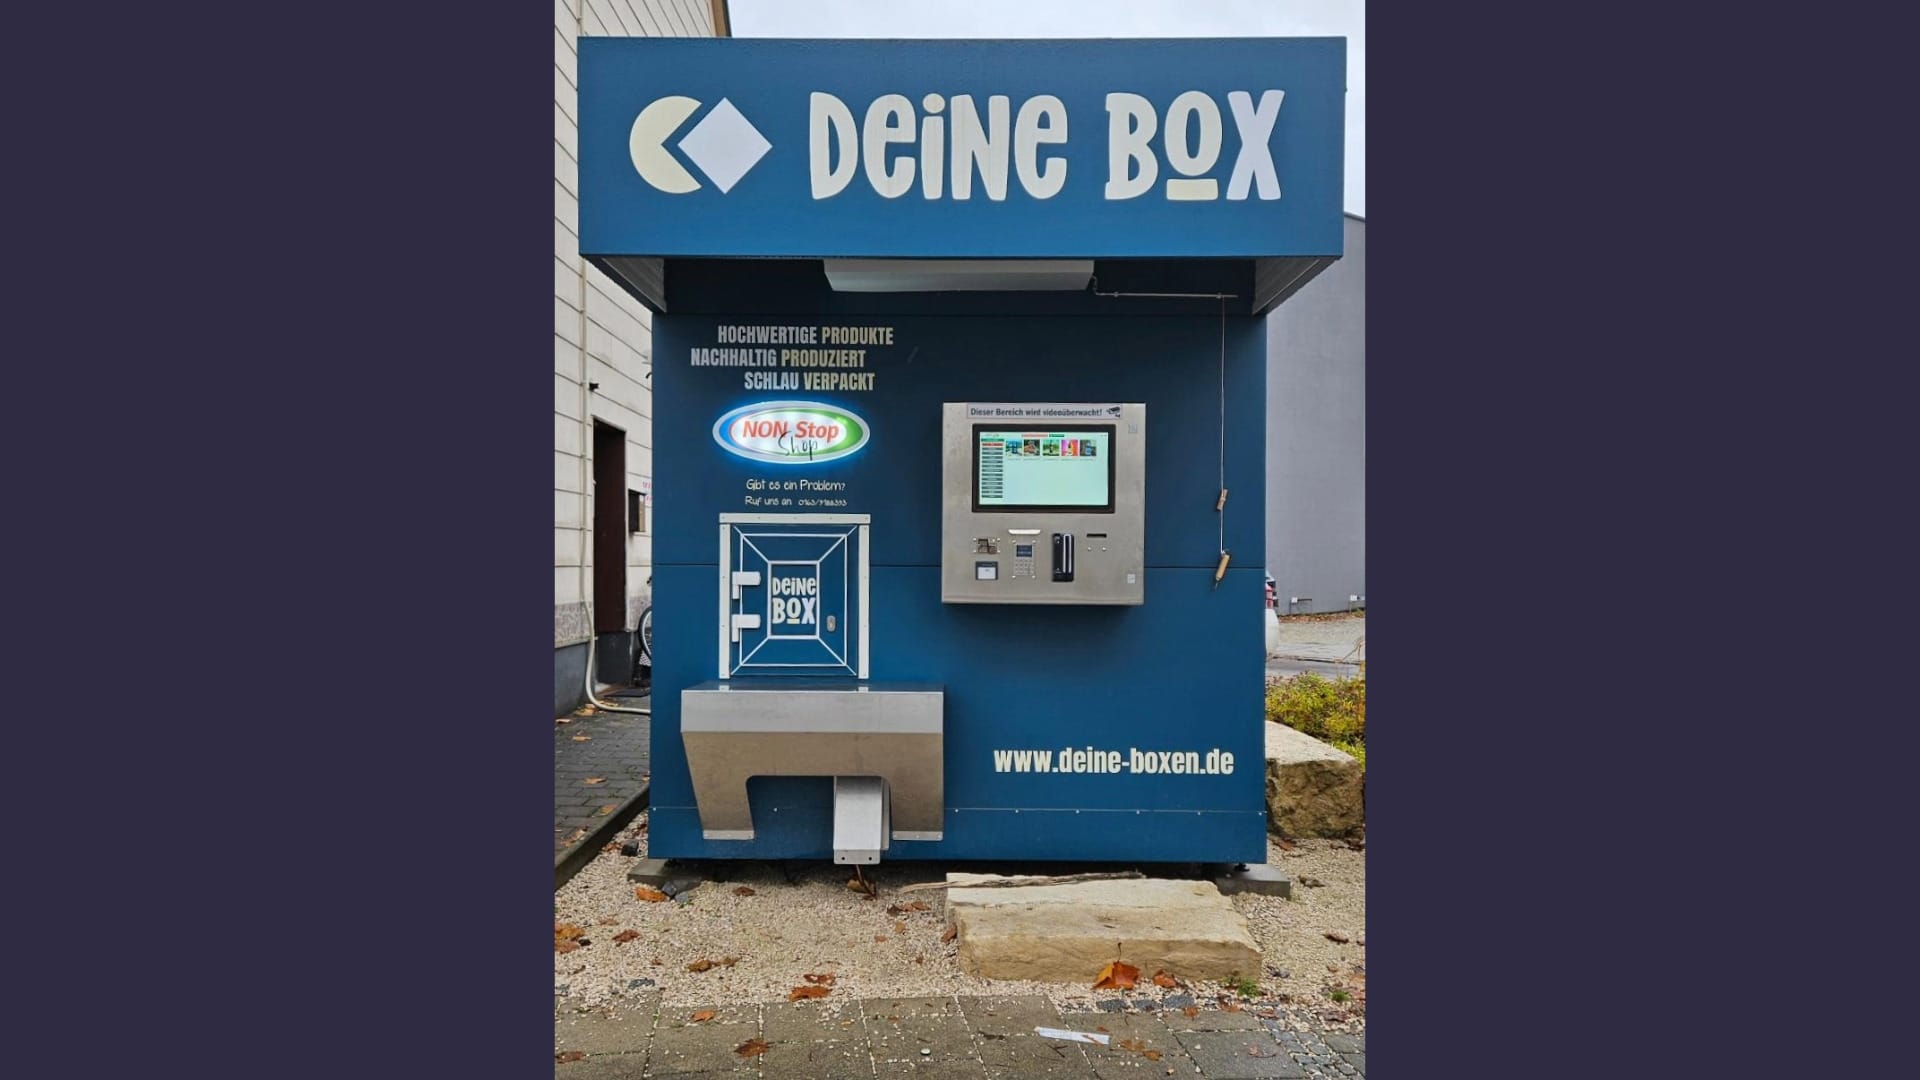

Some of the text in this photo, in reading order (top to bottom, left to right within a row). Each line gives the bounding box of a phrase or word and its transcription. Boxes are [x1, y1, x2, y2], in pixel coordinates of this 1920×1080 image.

[717, 325, 894, 345] HOCHWERTIGE PRODUKTE
[690, 348, 866, 368] NACHHALTIG PRODUZIERT
[744, 371, 876, 391] SCHLAU VERPACKT
[970, 407, 1103, 417] Dieser Bereich wird videoüberwacht!
[742, 420, 840, 443] NON Stop
[746, 479, 846, 491] Gibt es ein Problem?
[745, 495, 762, 506] Ruf
[764, 497, 779, 506] uns
[781, 498, 793, 506] an
[993, 746, 1235, 775] www.deine-boxen.de
